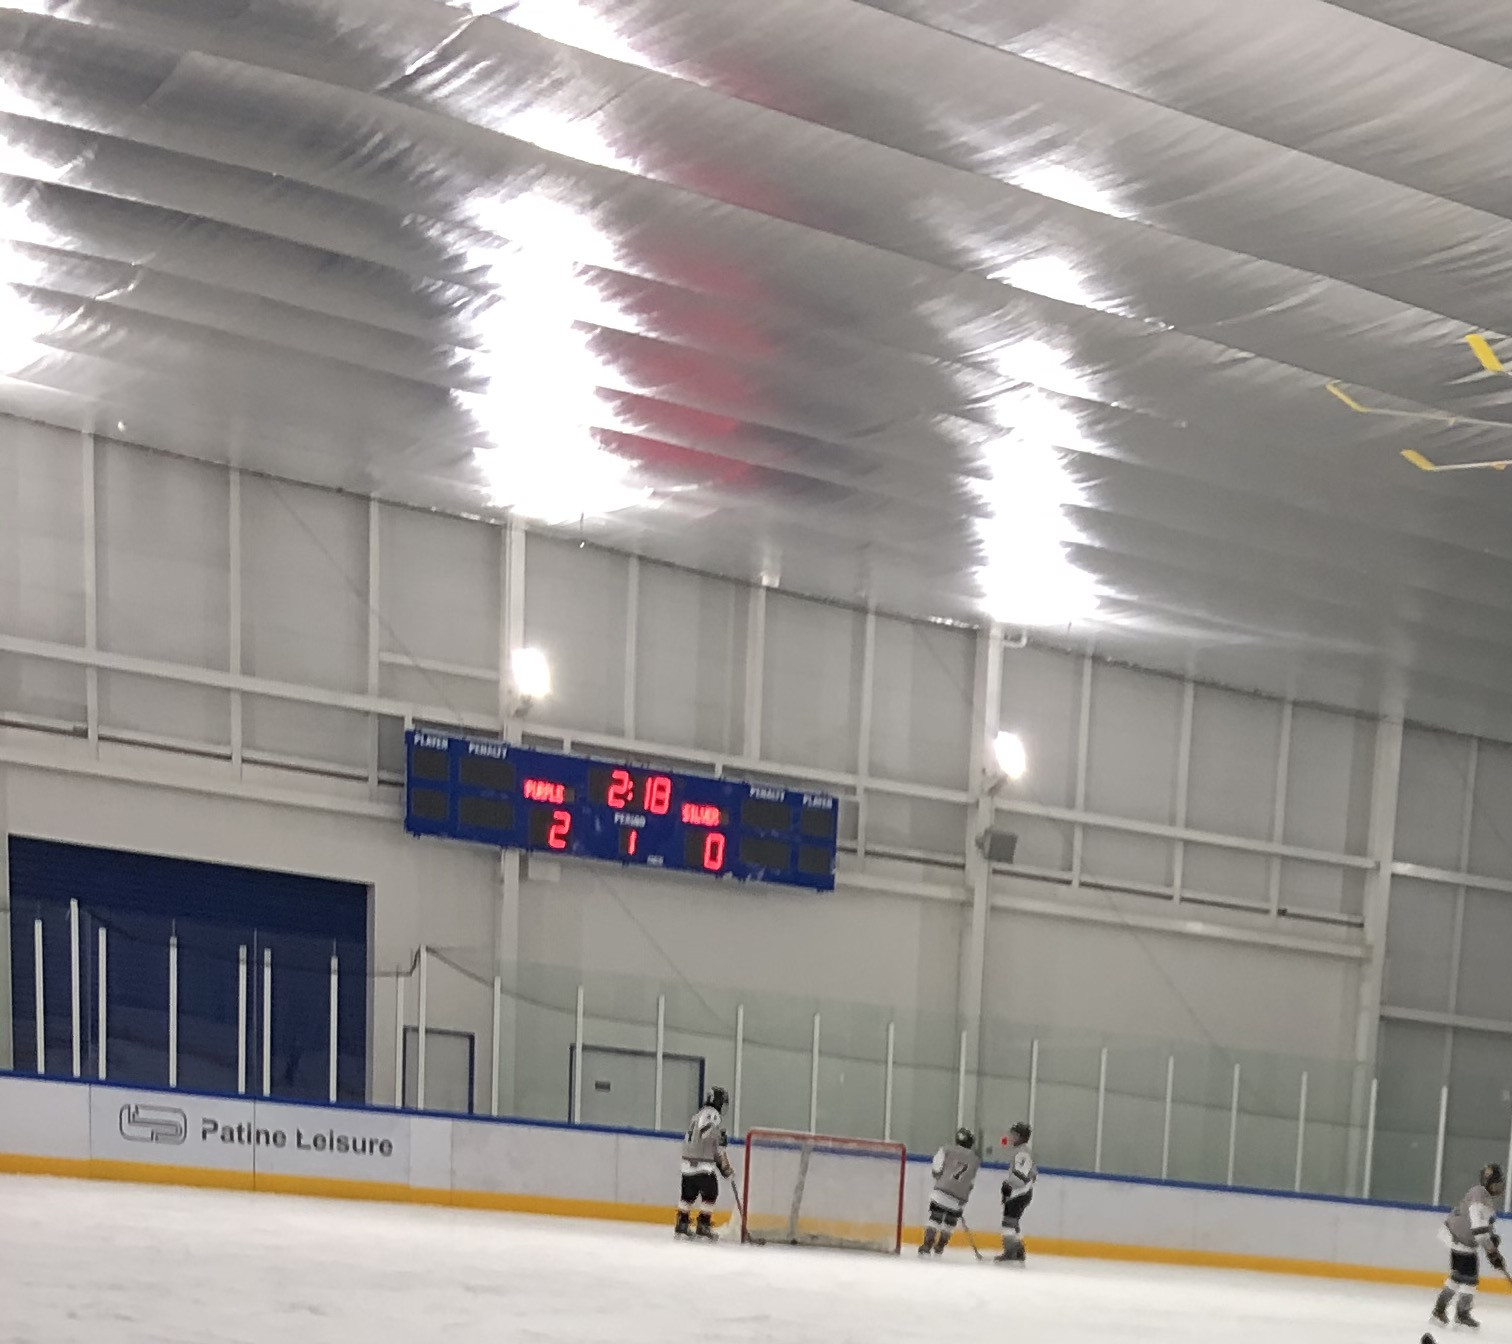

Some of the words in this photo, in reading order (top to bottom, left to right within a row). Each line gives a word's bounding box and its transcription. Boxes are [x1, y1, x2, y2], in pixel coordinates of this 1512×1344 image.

[607, 769, 672, 815] 2:18
[548, 810, 572, 849] 2
[627, 829, 638, 856] 1
[703, 832, 726, 871] 0
[201, 1117, 287, 1149] Patine
[296, 1128, 394, 1158] Leisure
